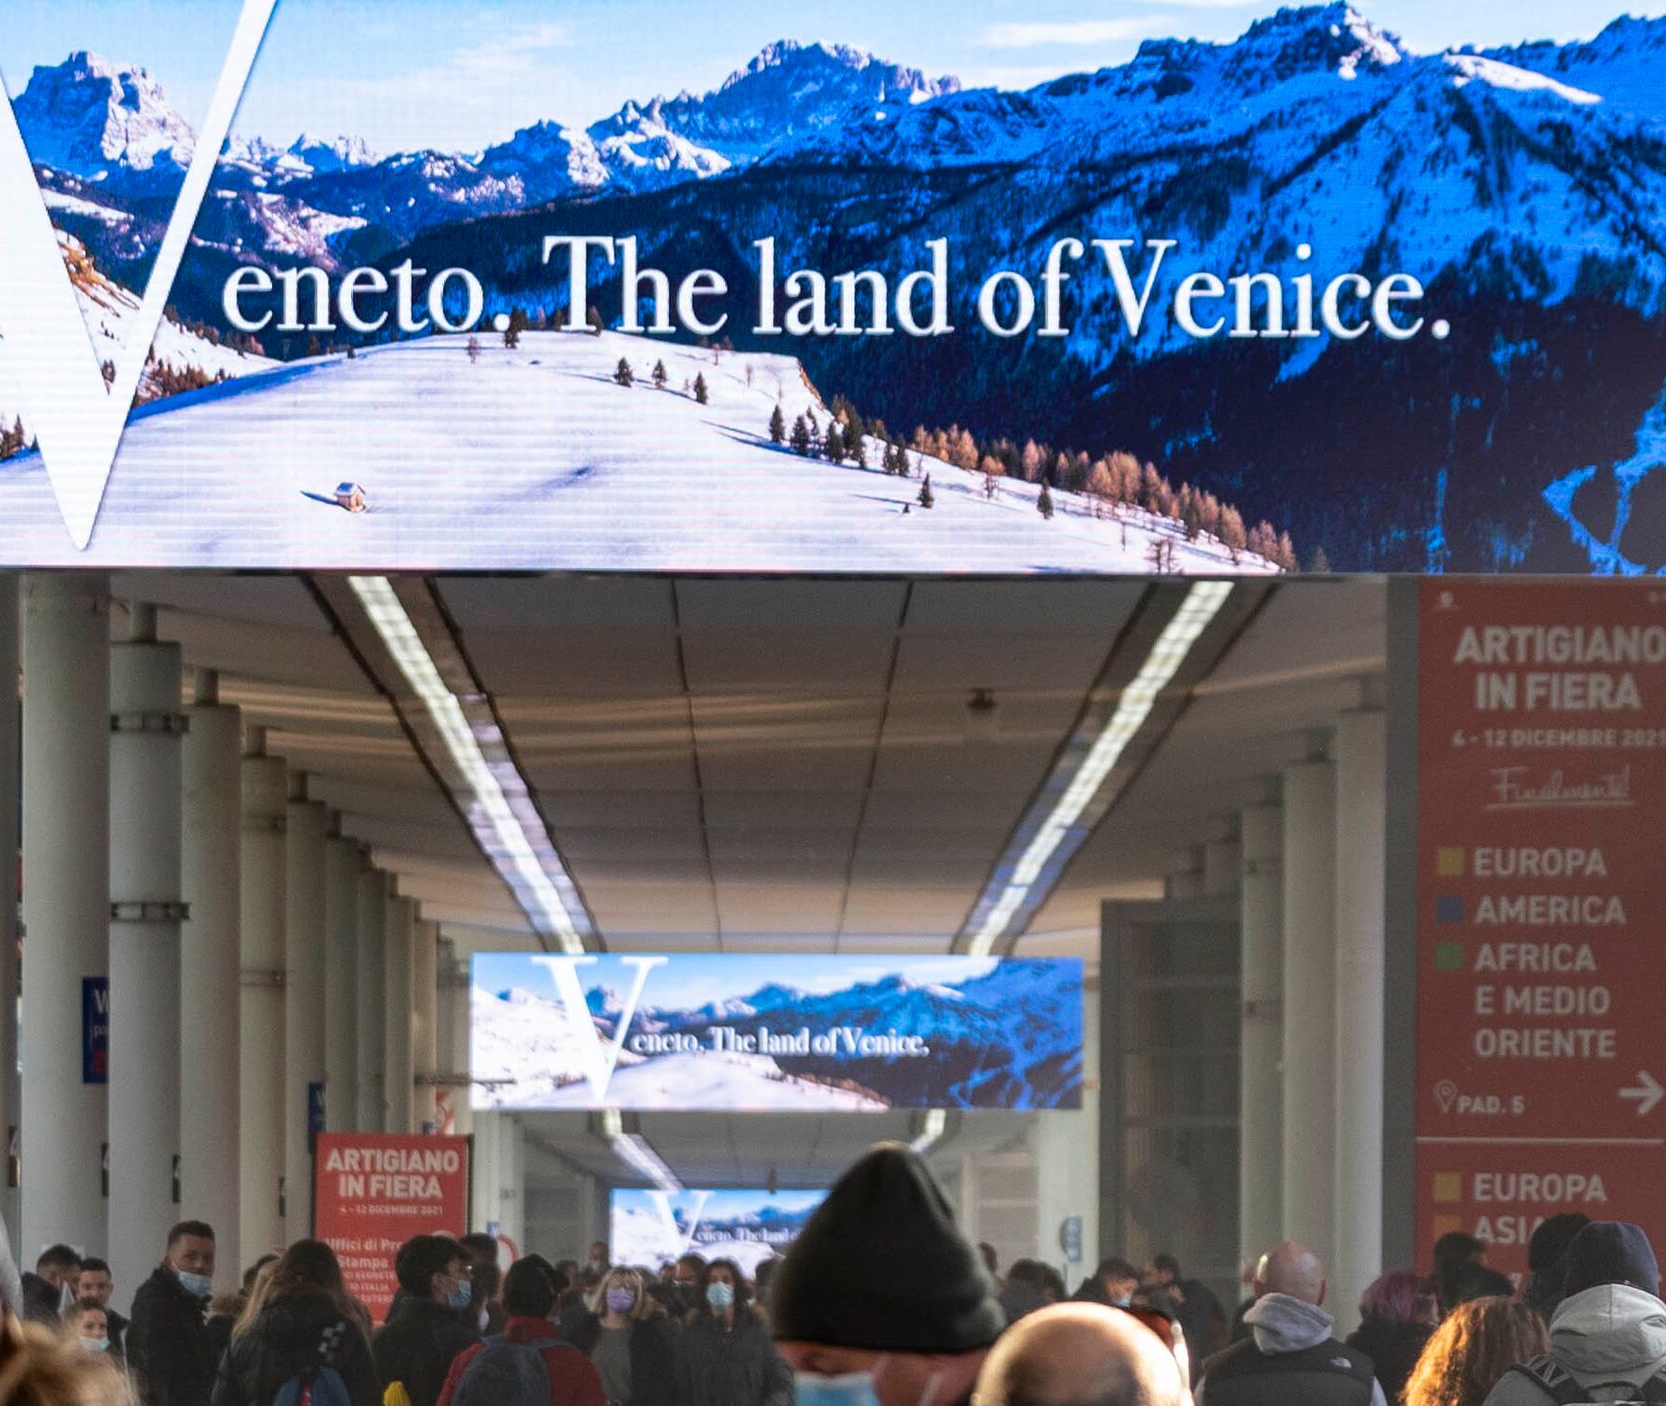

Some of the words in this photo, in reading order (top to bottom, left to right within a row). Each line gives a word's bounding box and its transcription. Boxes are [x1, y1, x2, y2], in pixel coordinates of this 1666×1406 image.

[542, 236, 727, 335] The
[754, 236, 955, 336] land
[978, 236, 1081, 337] of
[1092, 239, 1451, 340] Venice.
[1476, 671, 1517, 710] IN
[1526, 671, 1642, 711] FIERA
[1452, 729, 1466, 747] 4
[1485, 729, 1508, 748] 12
[1512, 729, 1617, 748] DICEMBRE
[1473, 847, 1608, 876] EUROPA
[1475, 896, 1627, 924] AMERICA
[1474, 943, 1598, 971] AFRICA
[1475, 985, 1495, 1014] E
[1503, 985, 1611, 1015] MEDIO
[709, 1026, 755, 1053] The
[758, 1026, 810, 1055] land
[812, 1026, 841, 1055] of
[841, 1027, 931, 1057] Venice.
[1474, 1028, 1617, 1059] ORIENTE
[1457, 1096, 1506, 1114] PAD.
[1512, 1095, 1525, 1114] 5
[325, 1148, 460, 1174] ARTIGIANO
[339, 1174, 365, 1198] IN
[370, 1174, 443, 1198] FIERA
[1473, 1173, 1608, 1201] EUROPA
[368, 1205, 418, 1216] DICEMBRE
